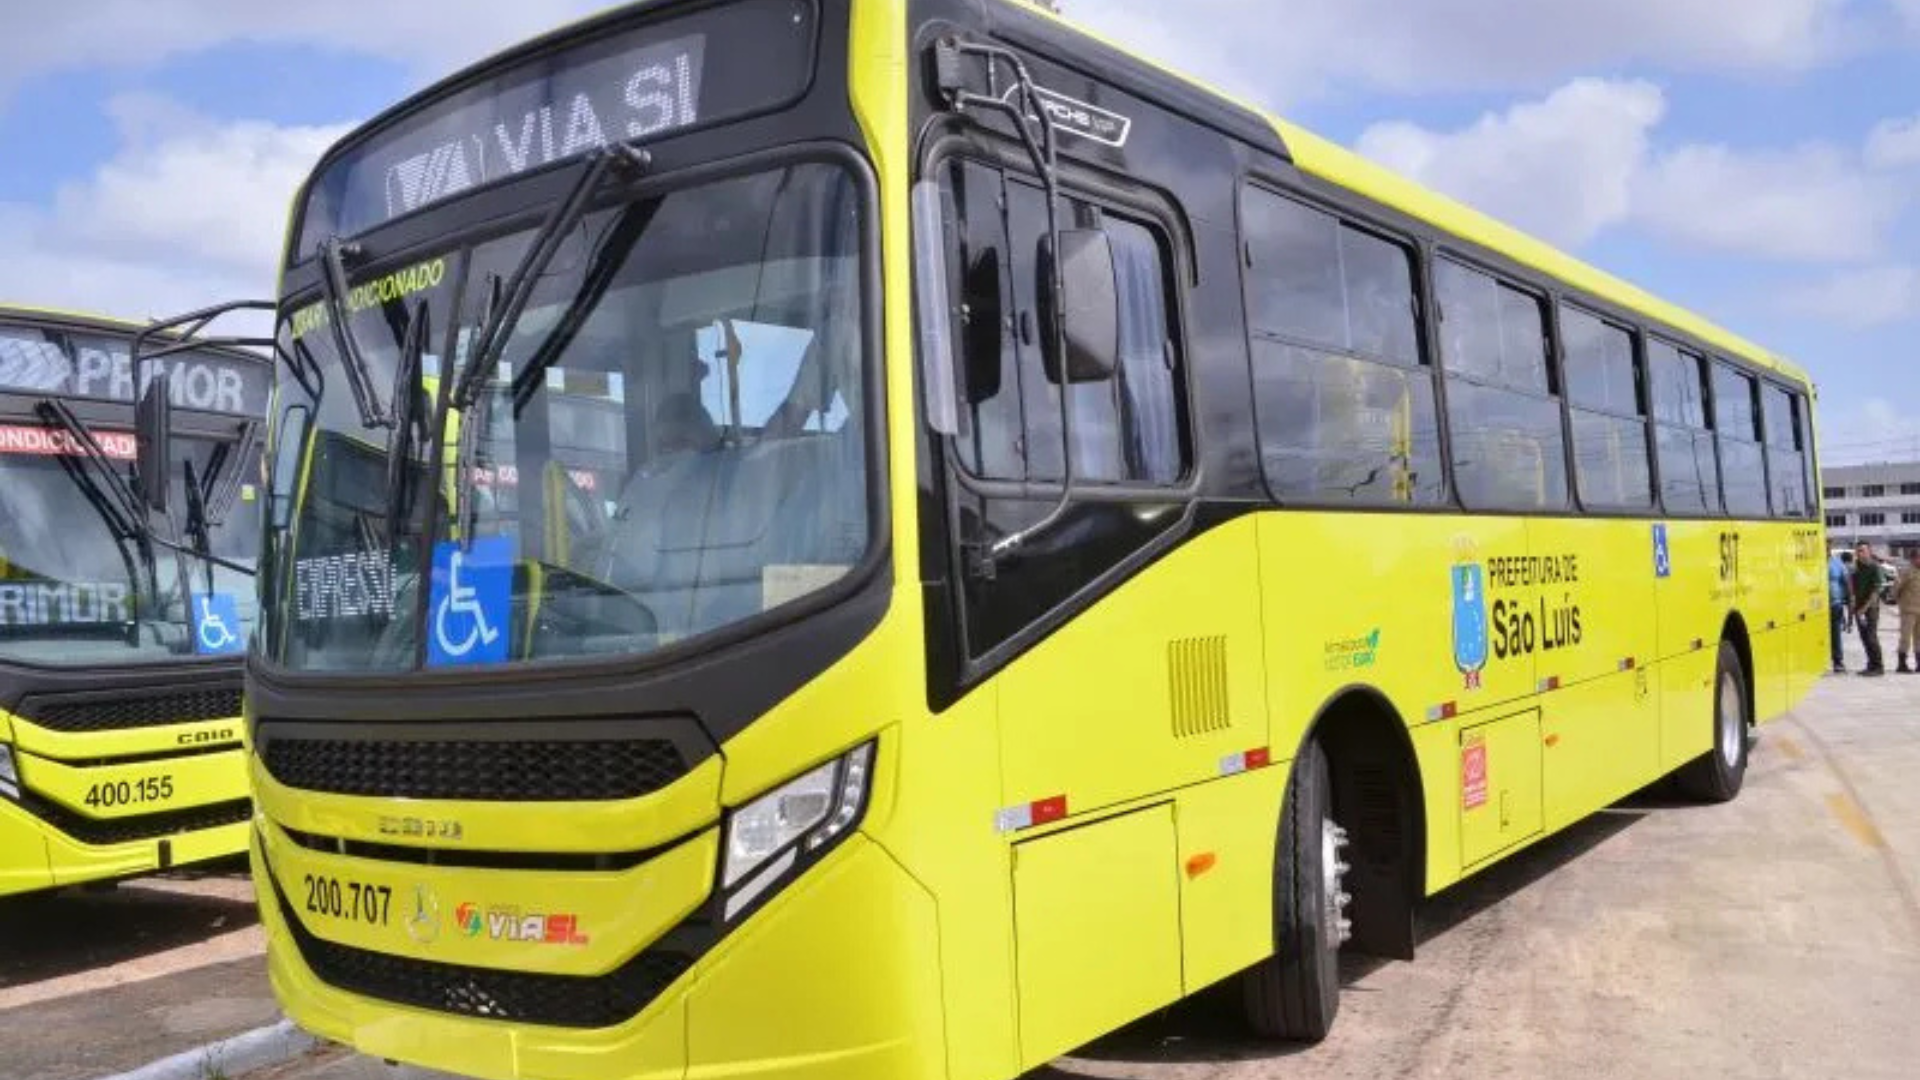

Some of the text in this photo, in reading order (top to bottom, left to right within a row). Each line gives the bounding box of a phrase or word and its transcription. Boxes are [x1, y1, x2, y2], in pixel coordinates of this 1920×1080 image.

[495, 92, 607, 173] VIA
[0, 583, 126, 624] RIMOR
[1492, 592, 1581, 660] São Luís
[85, 775, 174, 808] 400.155
[303, 874, 392, 927] 200.707
